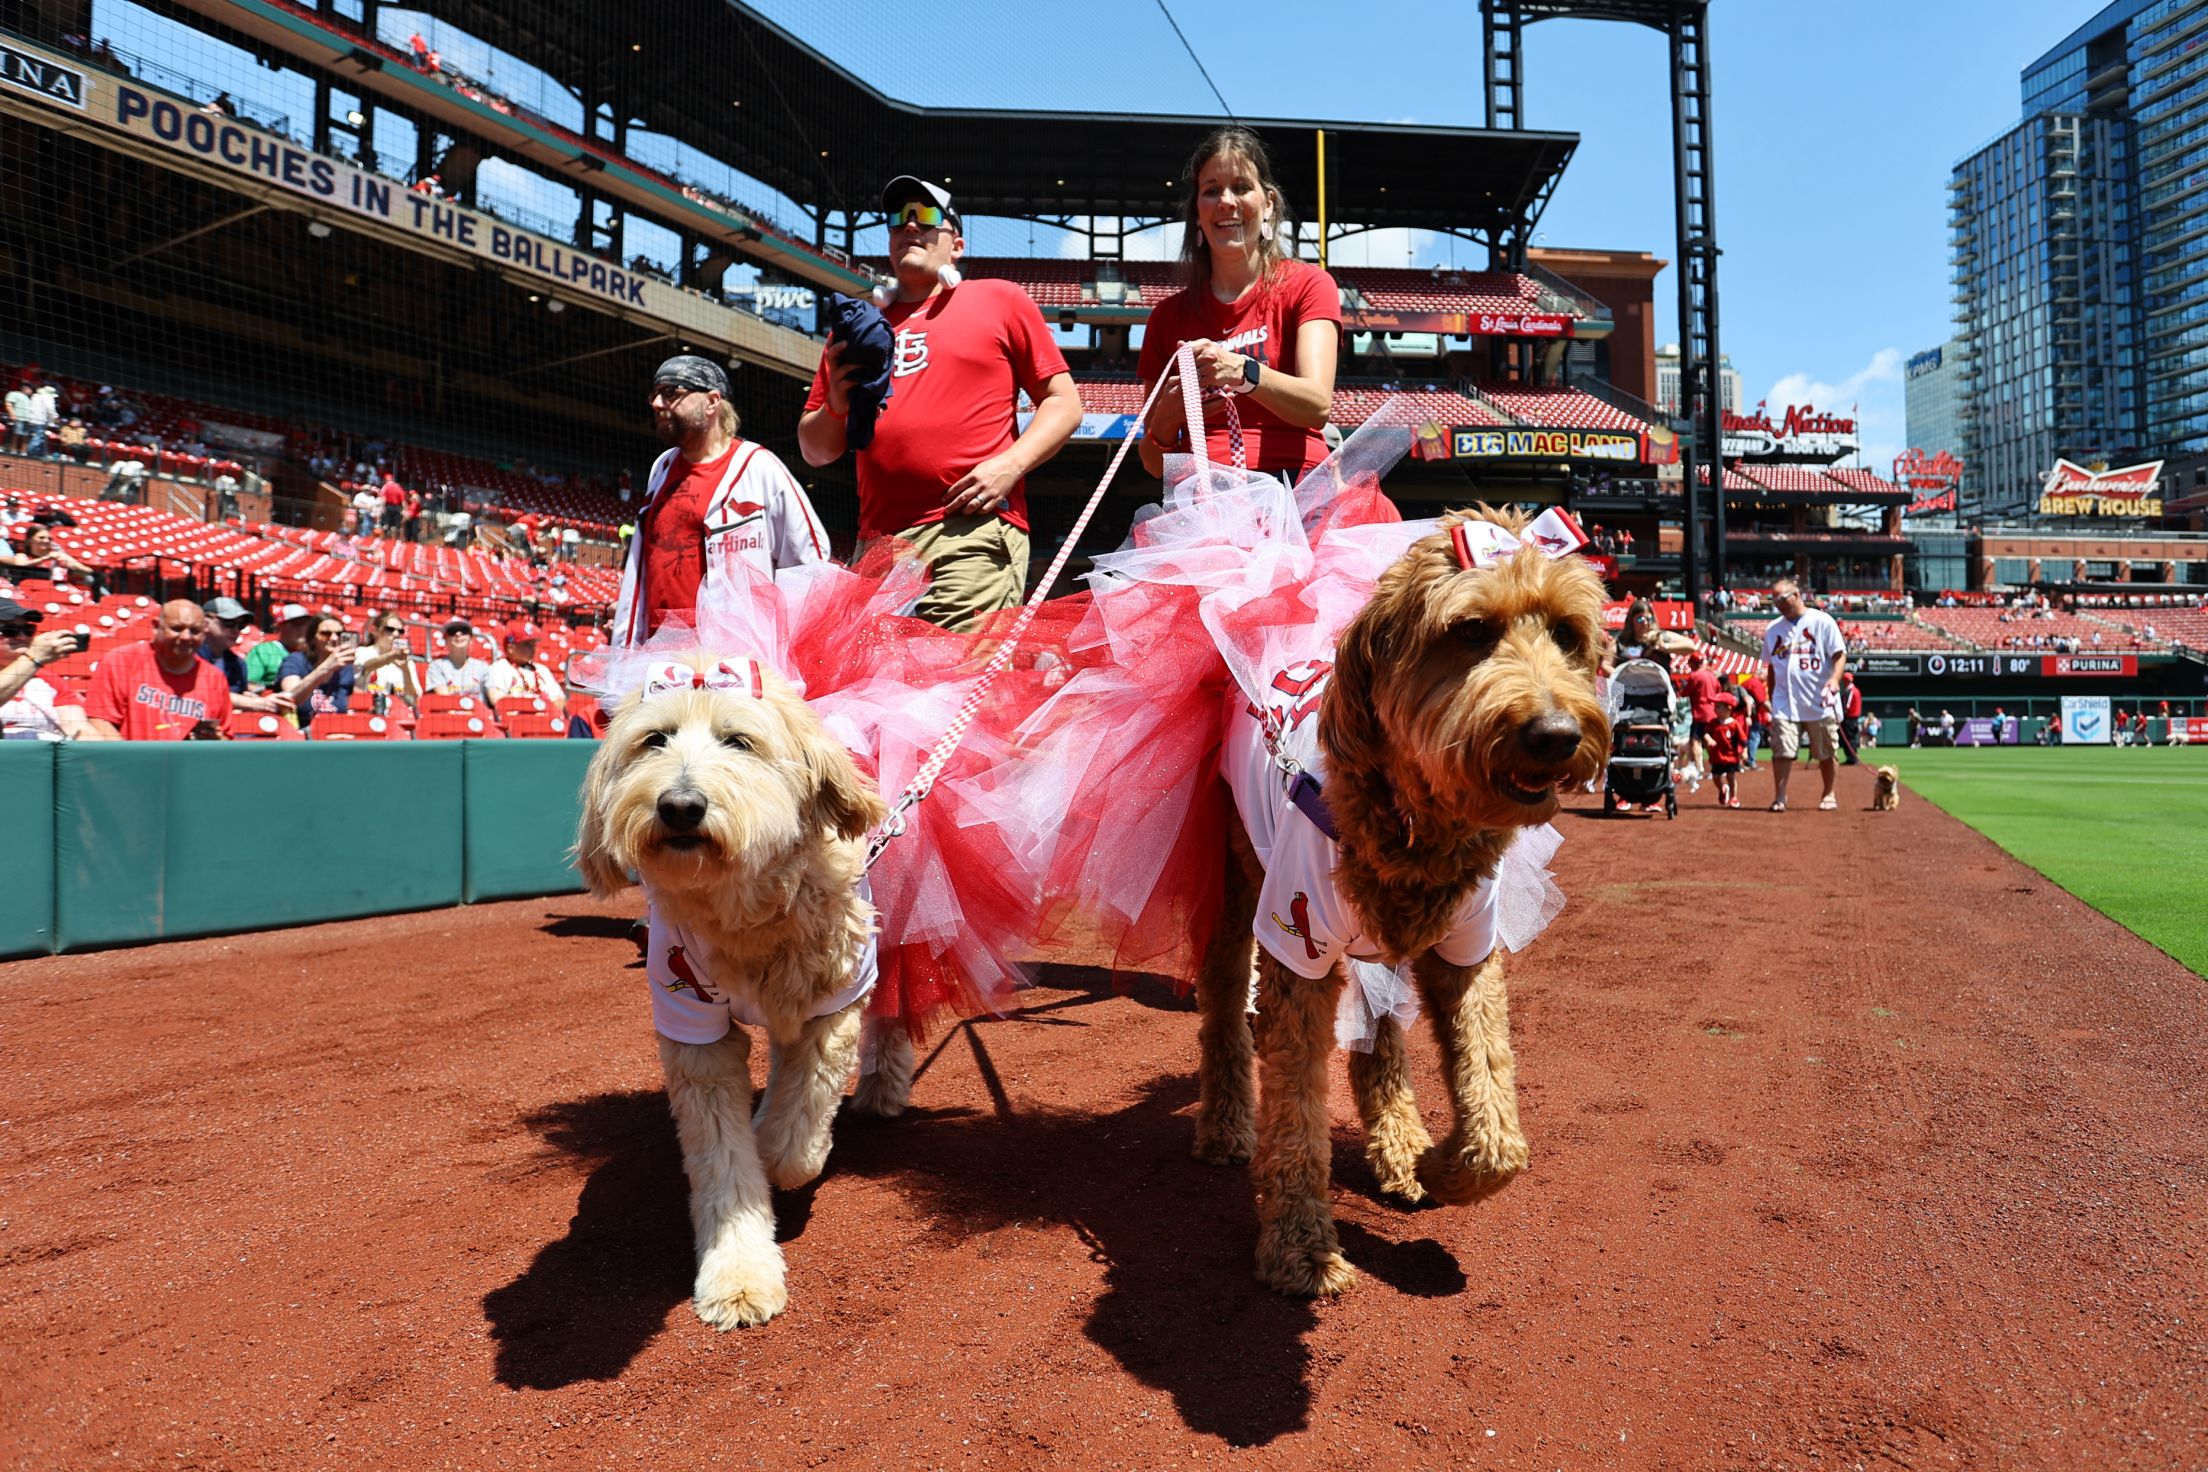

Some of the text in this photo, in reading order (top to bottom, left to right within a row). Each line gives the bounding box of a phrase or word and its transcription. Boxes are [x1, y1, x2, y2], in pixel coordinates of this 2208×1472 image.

[118, 86, 646, 307] POOCHES IN THE BALLPARK
[753, 288, 816, 315] pwc
[1774, 404, 1854, 438] Nation
[1454, 432, 1637, 461] BIG MAC LAND
[2038, 470, 2160, 494] Budweiser
[2039, 496, 2163, 517] BREW HOUSE
[1670, 611, 1686, 626] 21
[1799, 658, 1820, 671] 50
[1950, 658, 1984, 672] 12:11
[2071, 658, 2119, 672] PURINA
